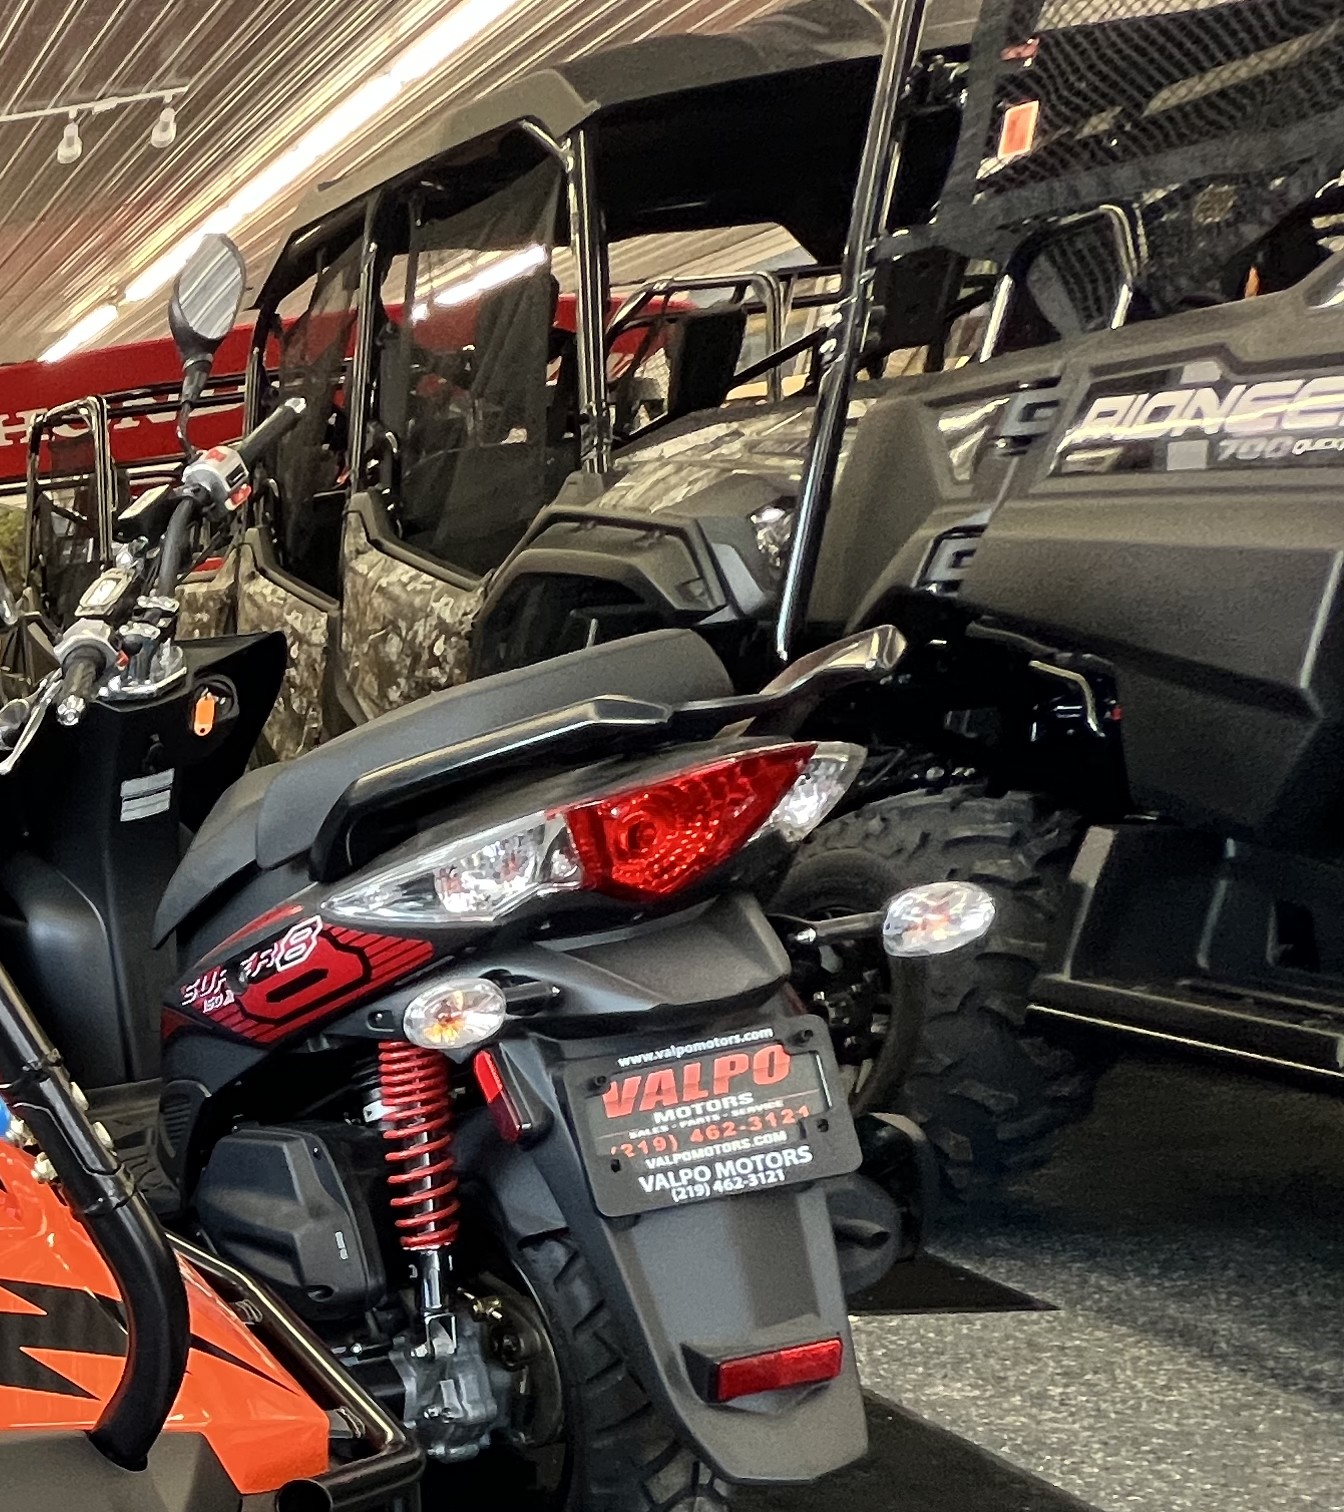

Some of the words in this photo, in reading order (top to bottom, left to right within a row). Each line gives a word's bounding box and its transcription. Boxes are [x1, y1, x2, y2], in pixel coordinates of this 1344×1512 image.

[1074, 376, 1344, 441] PIONEE
[1217, 435, 1296, 462] 700
[617, 1027, 774, 1068] www.valpomotors.com
[601, 1043, 792, 1119] VALPO
[628, 1124, 670, 1140] SALES
[680, 1115, 726, 1129] PARTS
[653, 1091, 754, 1125] MOTORS
[638, 1165, 712, 1194] VALPO
[714, 1145, 814, 1177] MOTORS
[645, 1129, 788, 1170] VALPOMOTORS.COM
[671, 1184, 711, 1203] (219)
[712, 1168, 786, 1194] 462-3121
